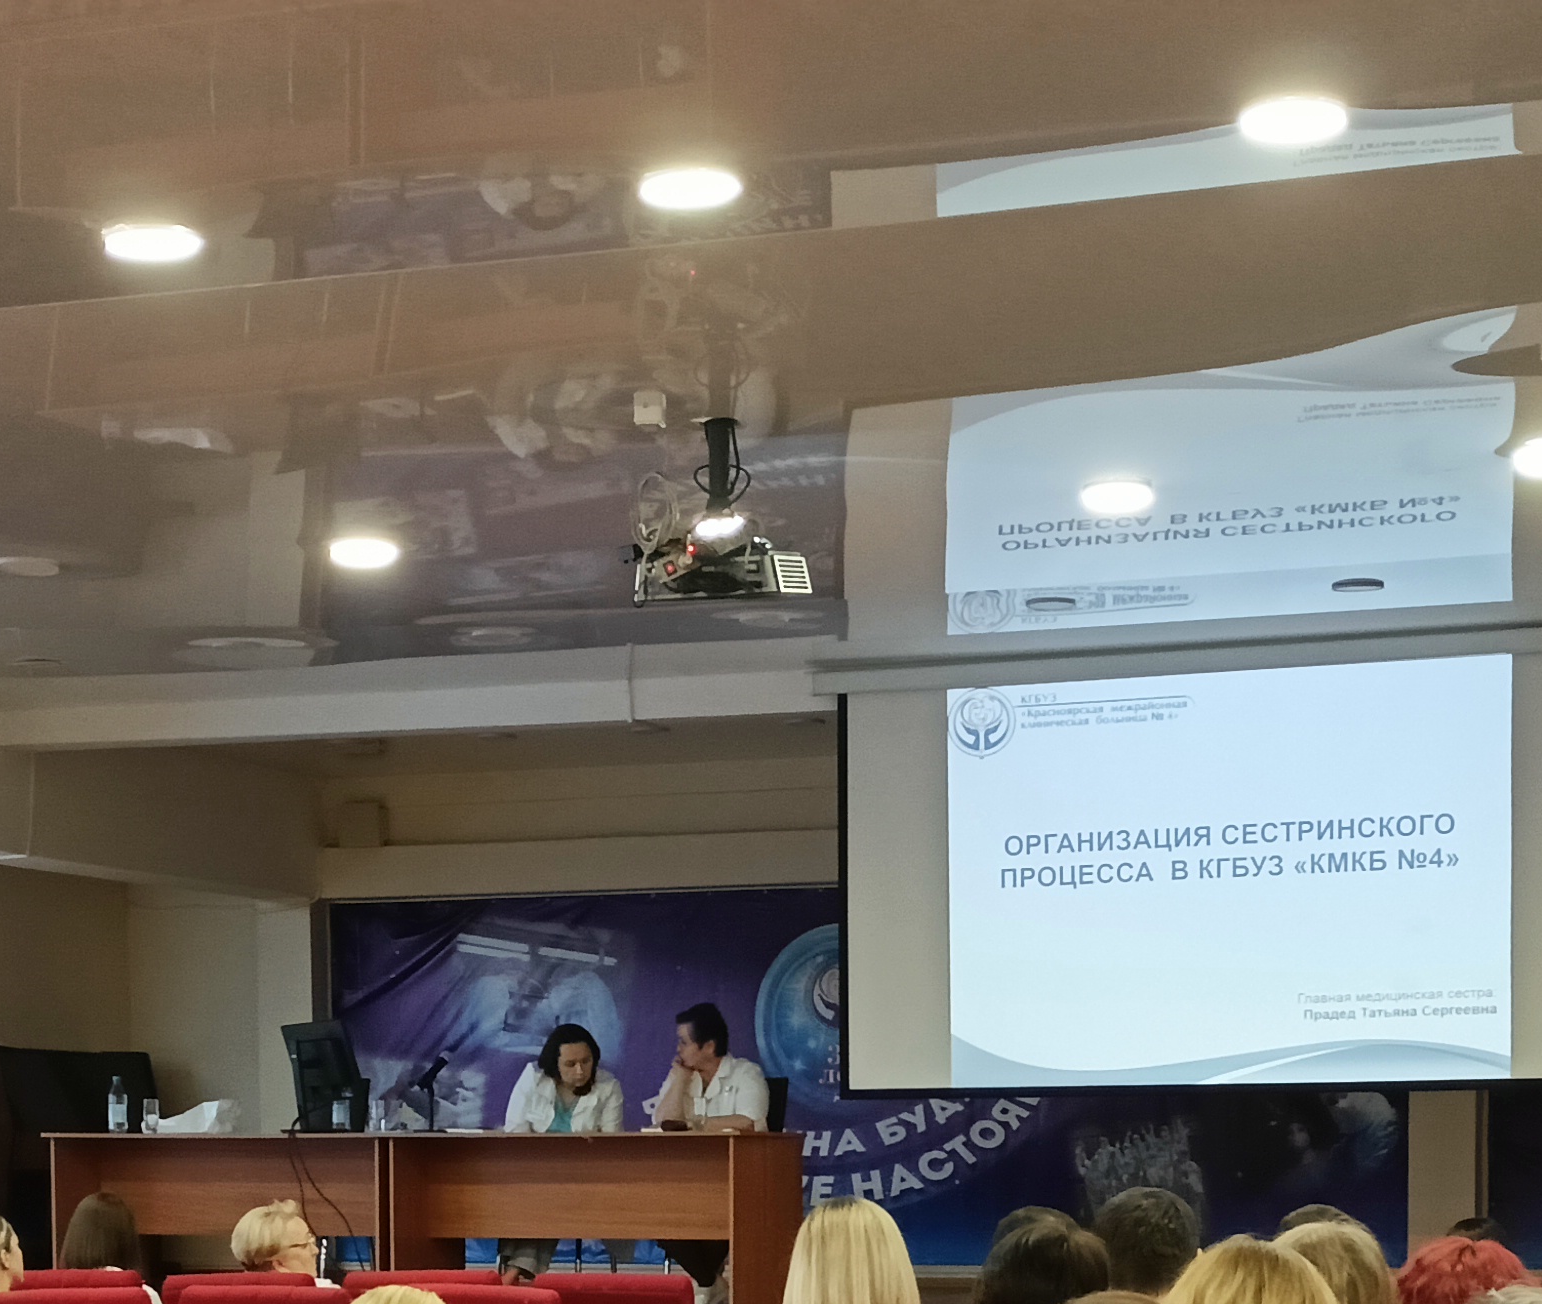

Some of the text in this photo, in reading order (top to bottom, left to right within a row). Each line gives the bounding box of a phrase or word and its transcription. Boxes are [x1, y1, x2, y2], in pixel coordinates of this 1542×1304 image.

[1021, 693, 1057, 704] КГБУЗ
[1004, 813, 1456, 856] ОРГАНИЗАЦИЯ СЕСТРИНСКОГО
[1000, 847, 1460, 889] ПРОЦЕССА В КГБУЗ «КМКБ №4»
[1297, 992, 1351, 1004] Главная
[1356, 990, 1443, 1004] медицинская
[1304, 1004, 1498, 1021] Прадед Татьяна Сергеевна
